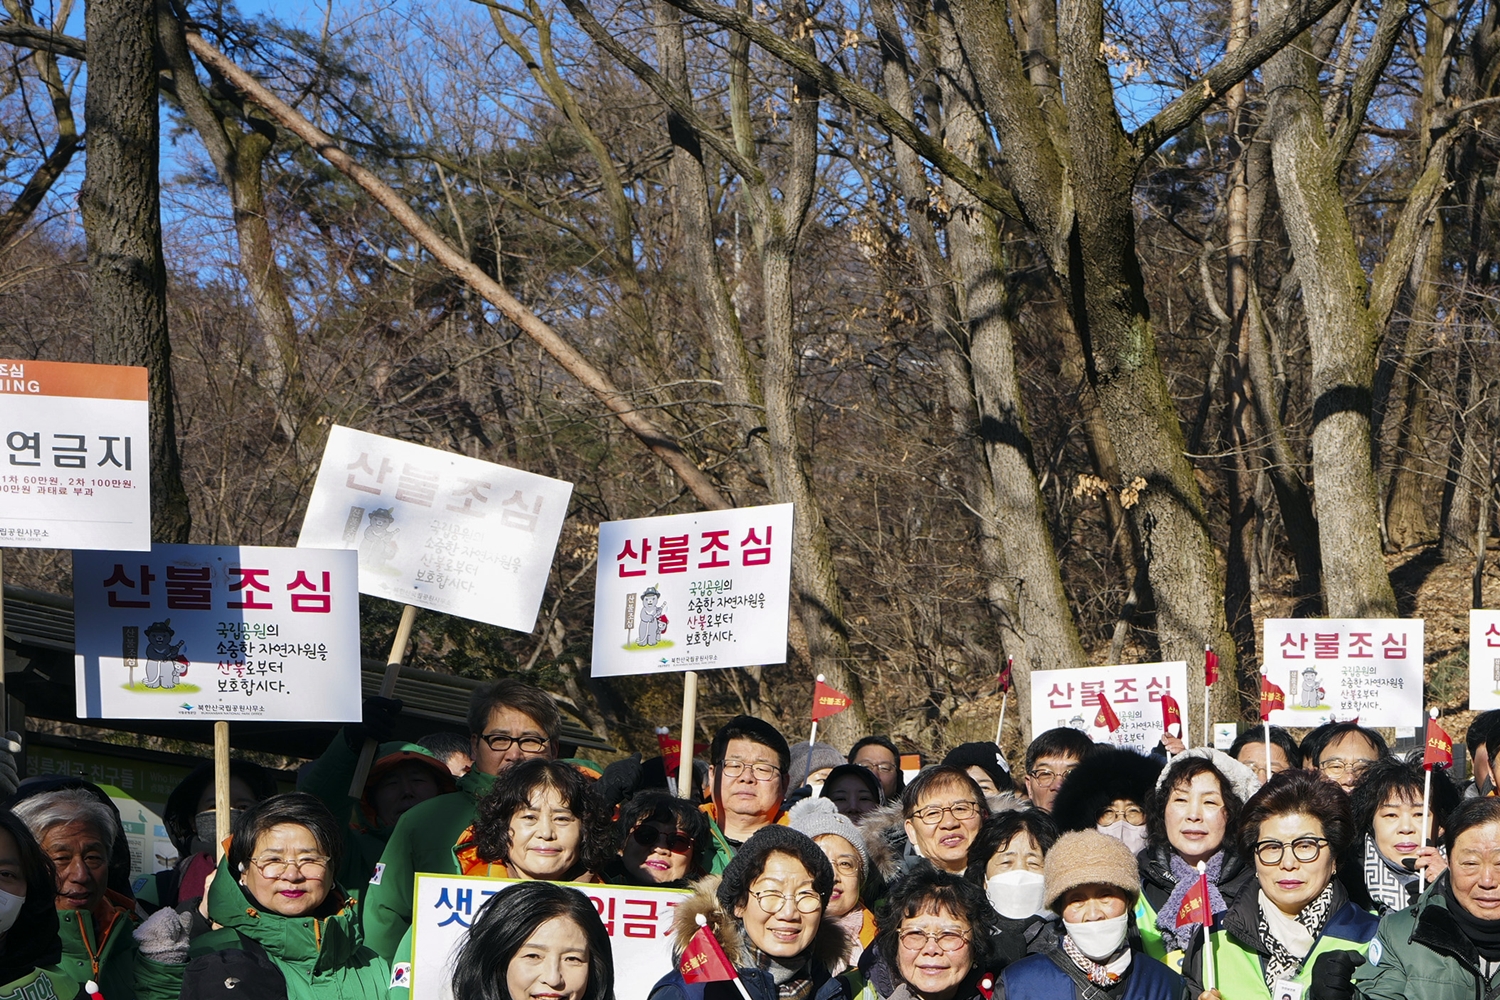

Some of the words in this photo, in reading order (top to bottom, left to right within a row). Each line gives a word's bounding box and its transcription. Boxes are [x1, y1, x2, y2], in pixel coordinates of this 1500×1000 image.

[6, 431, 132, 471] 연금지
[346, 452, 544, 532] 산불조심
[617, 525, 772, 578] 산불조심
[103, 564, 331, 613] 산불조심
[689, 579, 733, 596] 국립공원의
[688, 597, 715, 613] 소중한
[717, 593, 765, 609] 자연자원을
[216, 622, 279, 641] 국립공원의
[687, 613, 733, 631] 산불로부터
[686, 631, 737, 647] 보호합시다.
[1280, 632, 1407, 659] 산불조심
[216, 642, 255, 659] 소중한
[259, 643, 328, 661] 자연자원을
[217, 661, 283, 677] 산불로부터
[218, 679, 290, 696] 보호합시다.
